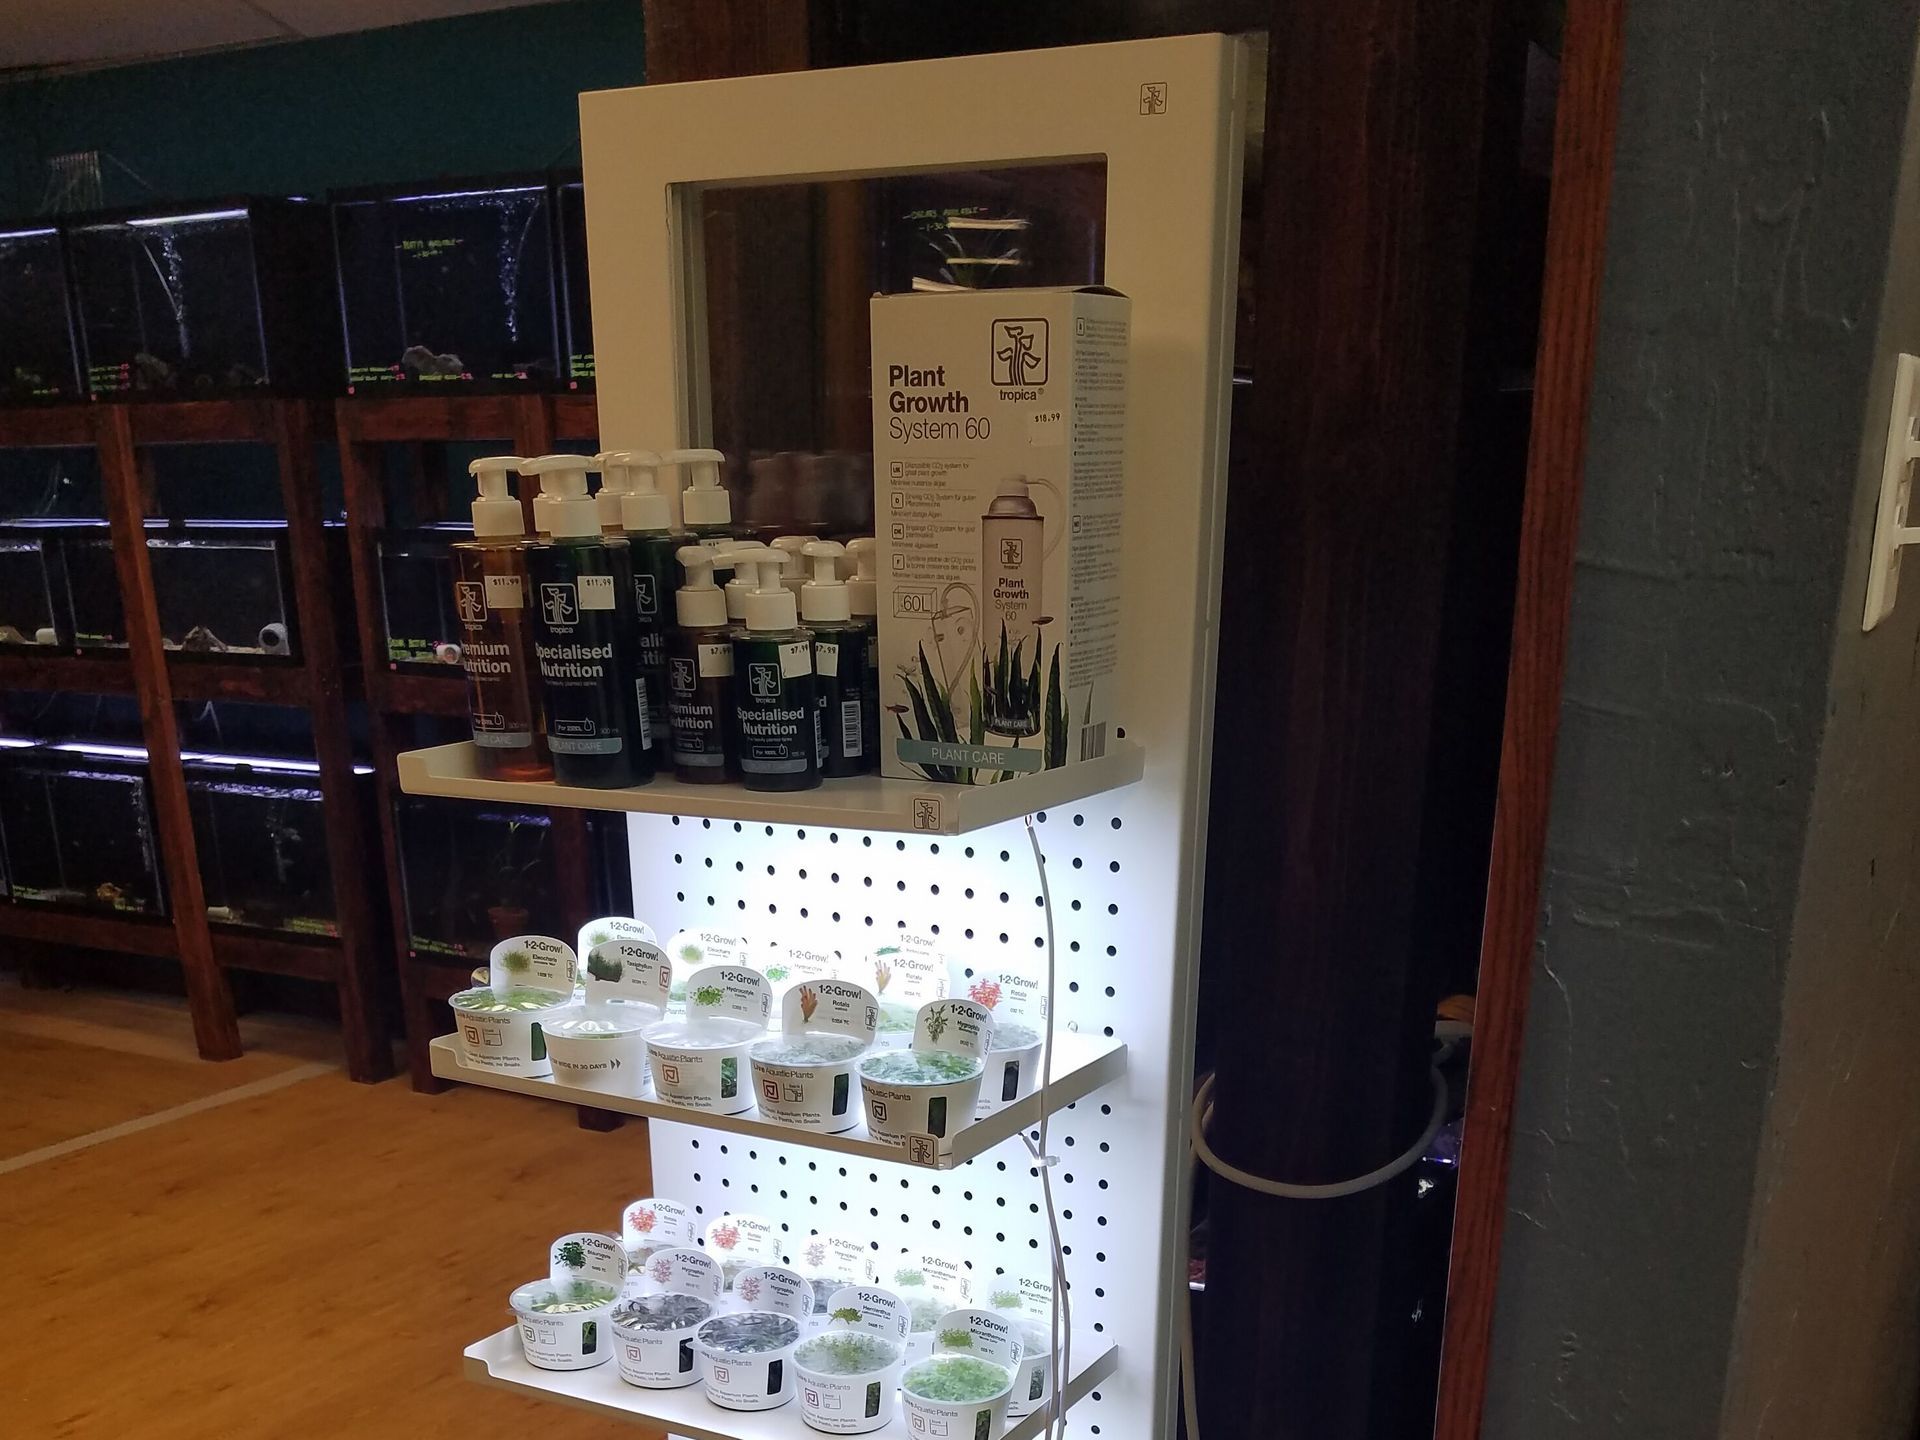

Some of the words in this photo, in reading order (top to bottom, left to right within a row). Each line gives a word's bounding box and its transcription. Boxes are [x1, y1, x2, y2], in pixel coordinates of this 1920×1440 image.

[889, 365, 945, 387] Plant
[889, 390, 969, 413] Growth
[1034, 412, 1061, 423] $18.99
[889, 417, 959, 444] System
[965, 417, 990, 440] 60
[492, 578, 519, 586] $11.99
[586, 578, 611, 586] $11.99
[998, 578, 1024, 588] Plant
[993, 589, 1029, 599] Growth
[902, 595, 932, 612] 60L
[994, 599, 1028, 611] System
[1005, 611, 1017, 621] 60
[550, 626, 574, 635] tropica
[463, 658, 511, 675] utrition
[541, 659, 604, 679] Nutrition
[737, 706, 805, 722] Specialised
[671, 716, 714, 730] utrition
[742, 722, 798, 736] Nutrition
[931, 747, 970, 762] PLANT
[972, 749, 1005, 765] CARE
[1010, 989, 1027, 998] Rotala
[832, 999, 850, 1008] Rotala
[465, 1013, 488, 1024] Aquatic
[488, 1016, 511, 1025] Plants
[657, 1051, 680, 1063] Aquatic
[679, 1054, 703, 1064] Plants
[572, 1062, 579, 1070] IN
[589, 1062, 608, 1071] DAYS
[765, 1068, 790, 1079] Aquatic
[790, 1070, 814, 1080] Plants
[888, 1091, 912, 1102] Plants
[543, 1319, 564, 1328] Plants
[642, 1337, 663, 1346] Plants
[731, 1358, 753, 1367] Plants
[829, 1383, 851, 1392] Plants
[914, 1404, 936, 1416] Aquatic
[936, 1410, 959, 1418] Plants
